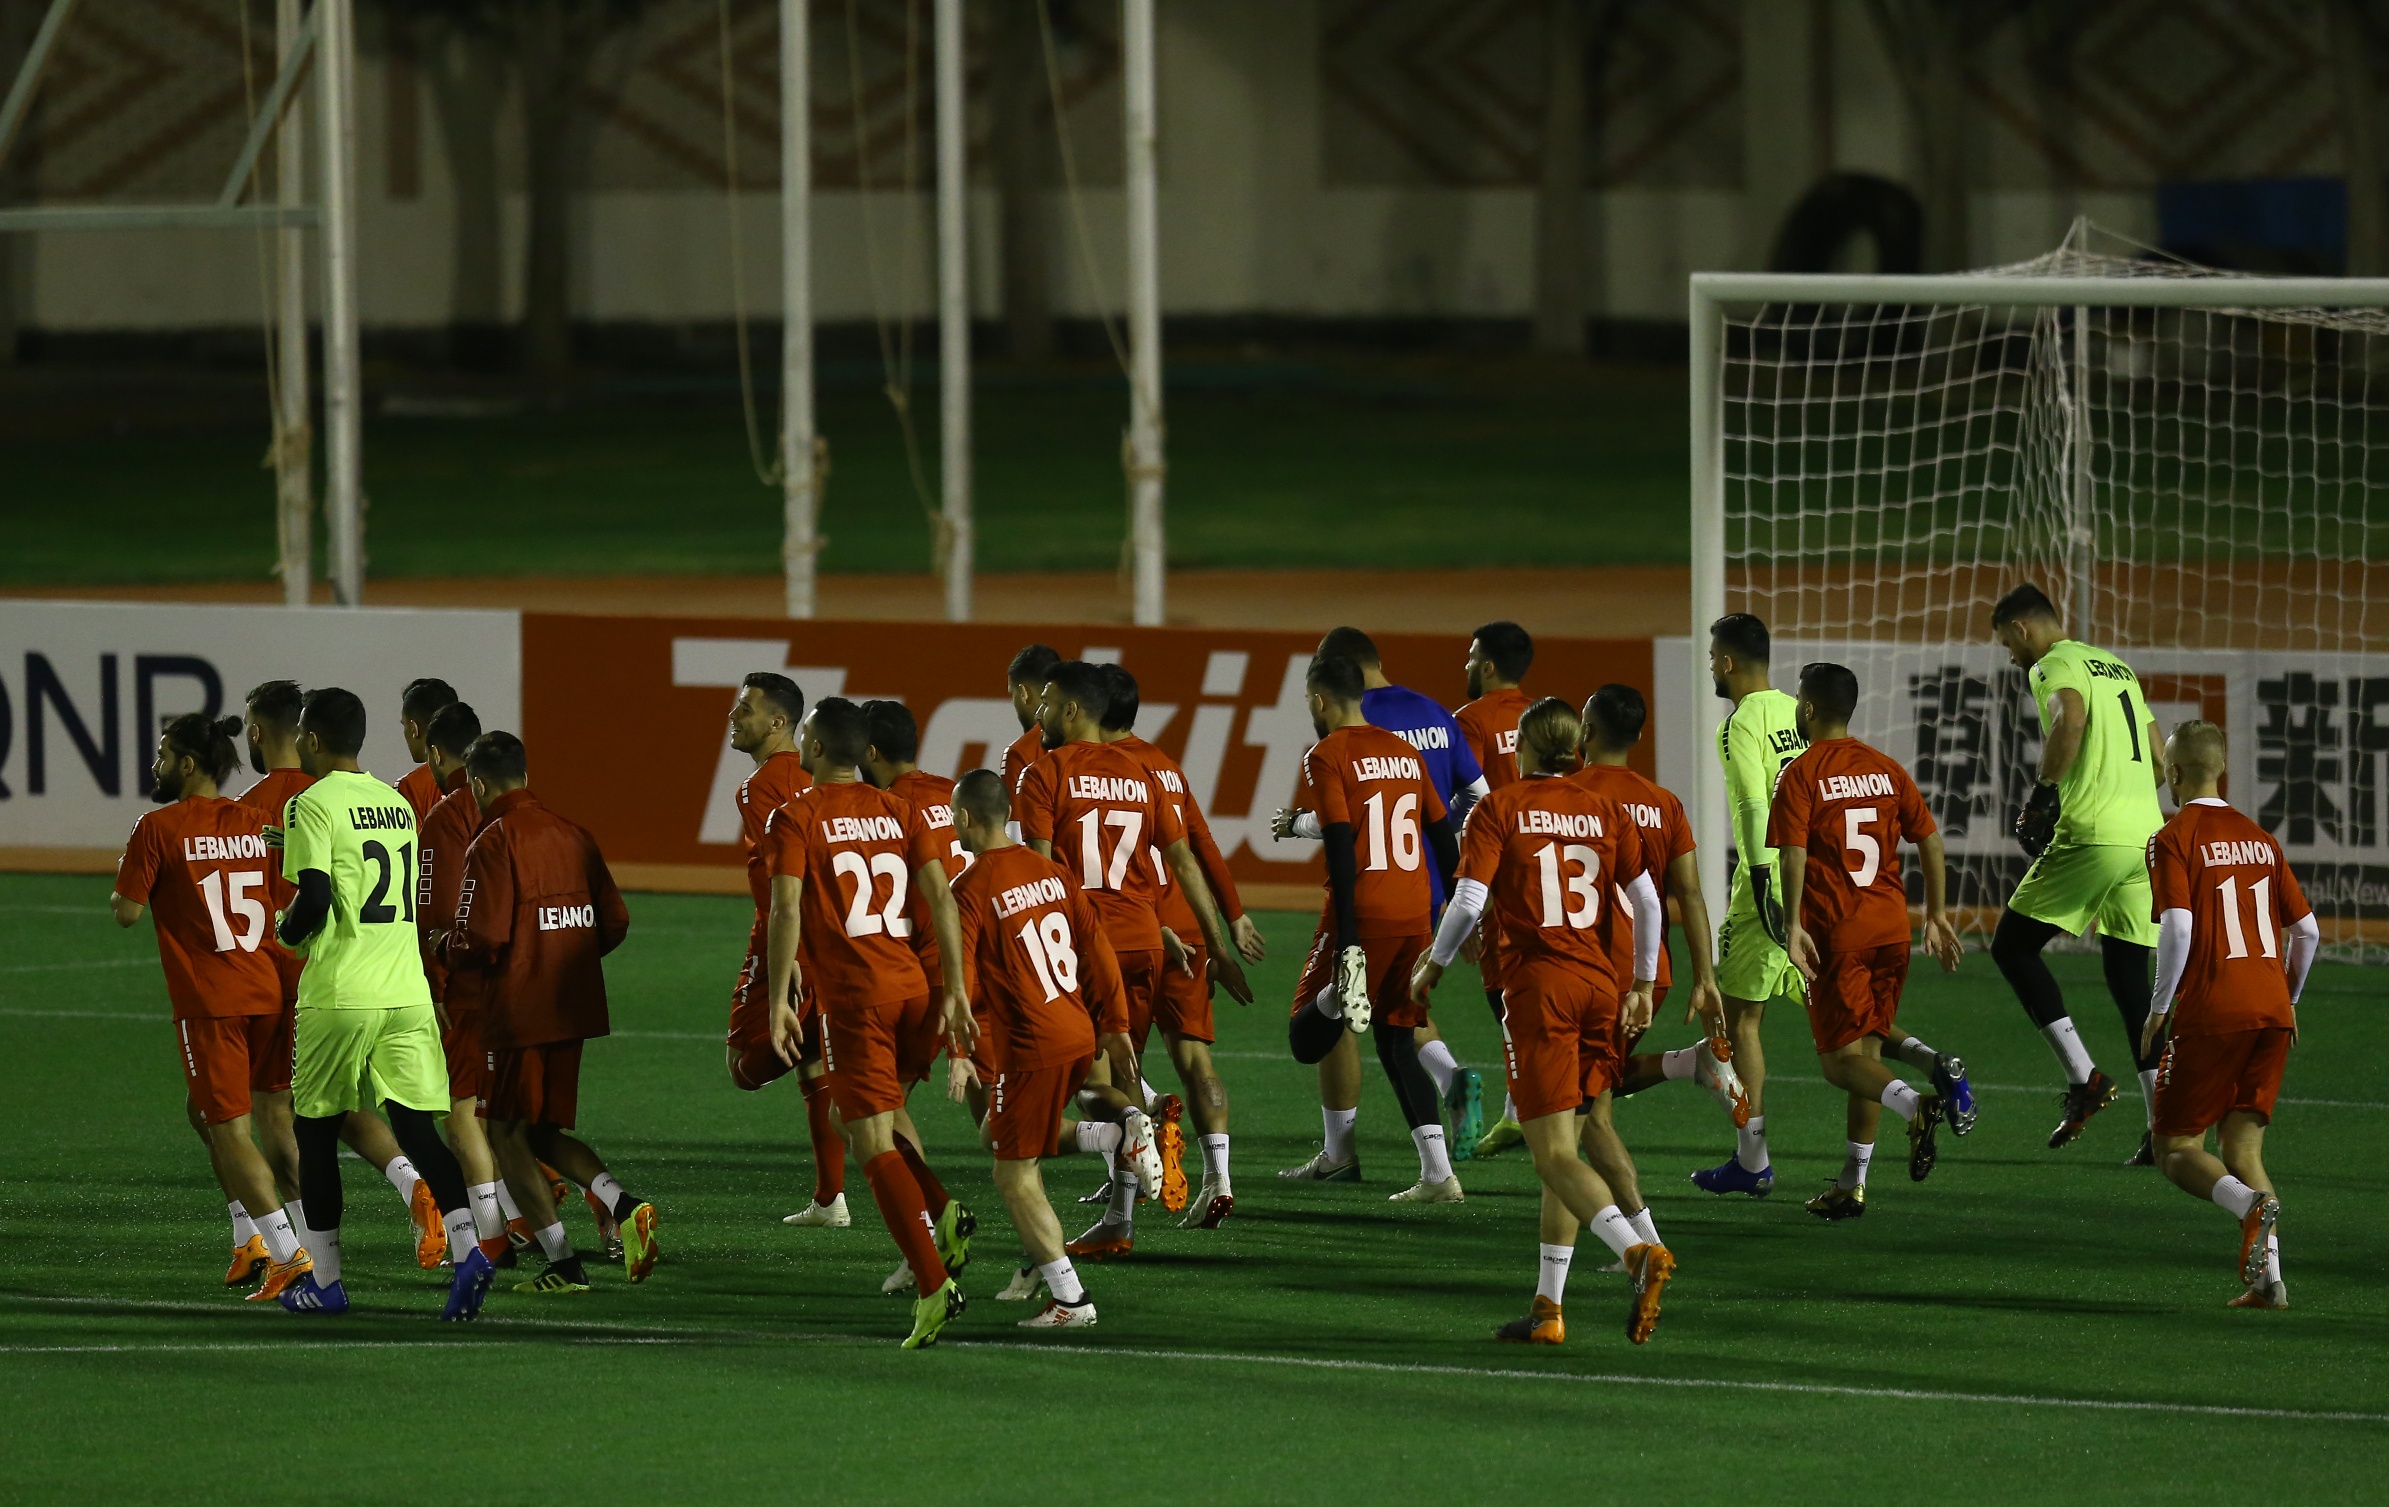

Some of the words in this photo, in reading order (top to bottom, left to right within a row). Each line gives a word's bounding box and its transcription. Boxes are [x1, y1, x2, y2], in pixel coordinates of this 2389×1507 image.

[0, 650, 231, 798] NB
[1391, 726, 1449, 751] BANON
[2117, 689, 2142, 763] 1
[1068, 775, 1148, 804] LEBANON
[1353, 756, 1421, 782] LEBANON
[1818, 773, 1894, 802] LEBANON
[183, 834, 267, 862] LEBANON
[349, 806, 414, 831] LEBANON
[821, 816, 904, 844] LEBANON
[1363, 790, 1420, 872] 16
[1517, 810, 1603, 838] LEBANON
[1844, 807, 1880, 887] 5
[1076, 807, 1143, 890] 17
[2200, 840, 2275, 868] LEBANON
[197, 869, 266, 953] 15
[359, 840, 414, 924] 21
[832, 851, 912, 938] 22
[991, 876, 1066, 920] LEBANON
[1532, 841, 1600, 929] 13
[538, 904, 597, 931] LEANO
[2215, 875, 2277, 960] 11
[1015, 911, 1078, 1004] 18
